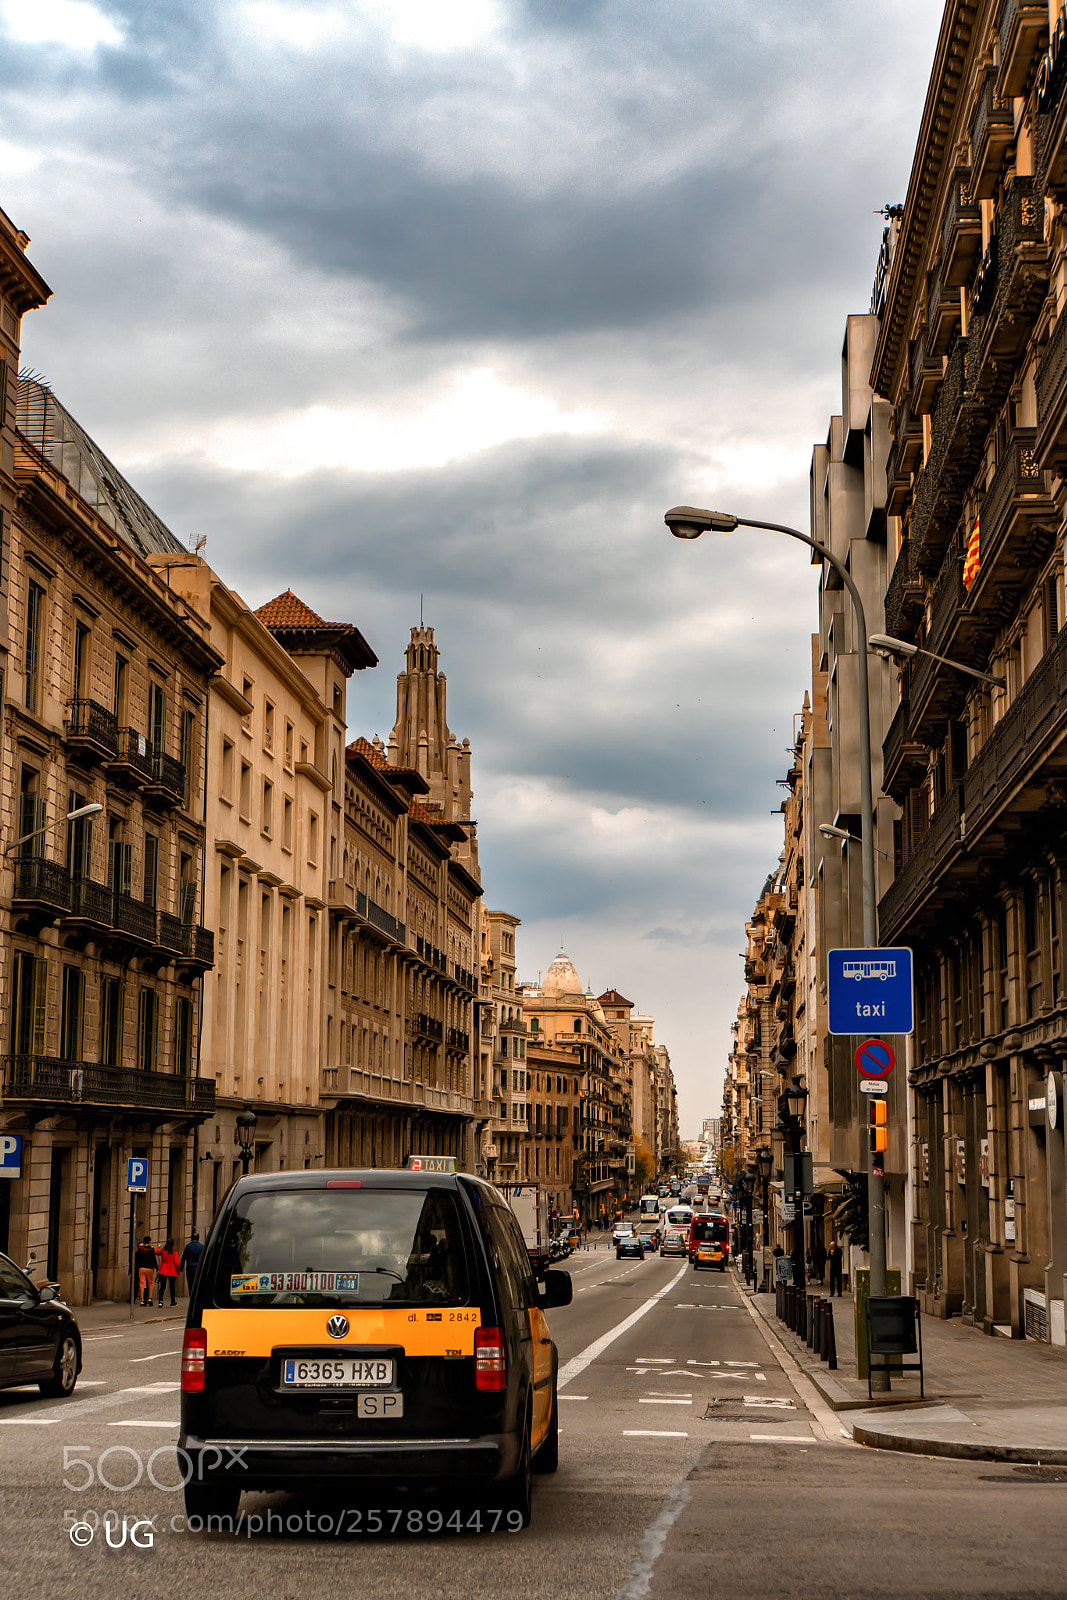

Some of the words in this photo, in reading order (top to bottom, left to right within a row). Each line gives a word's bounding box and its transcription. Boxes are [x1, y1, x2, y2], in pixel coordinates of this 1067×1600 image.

[856, 1001, 886, 1017] taxi
[0, 1137, 17, 1165] P
[131, 1162, 144, 1182] P
[425, 1159, 446, 1171] TAXI
[449, 1313, 477, 1322] 2842
[635, 1358, 761, 1367] BUS
[297, 1363, 345, 1380] 6365
[351, 1363, 387, 1380] HXB
[625, 1367, 767, 1381] TAXI
